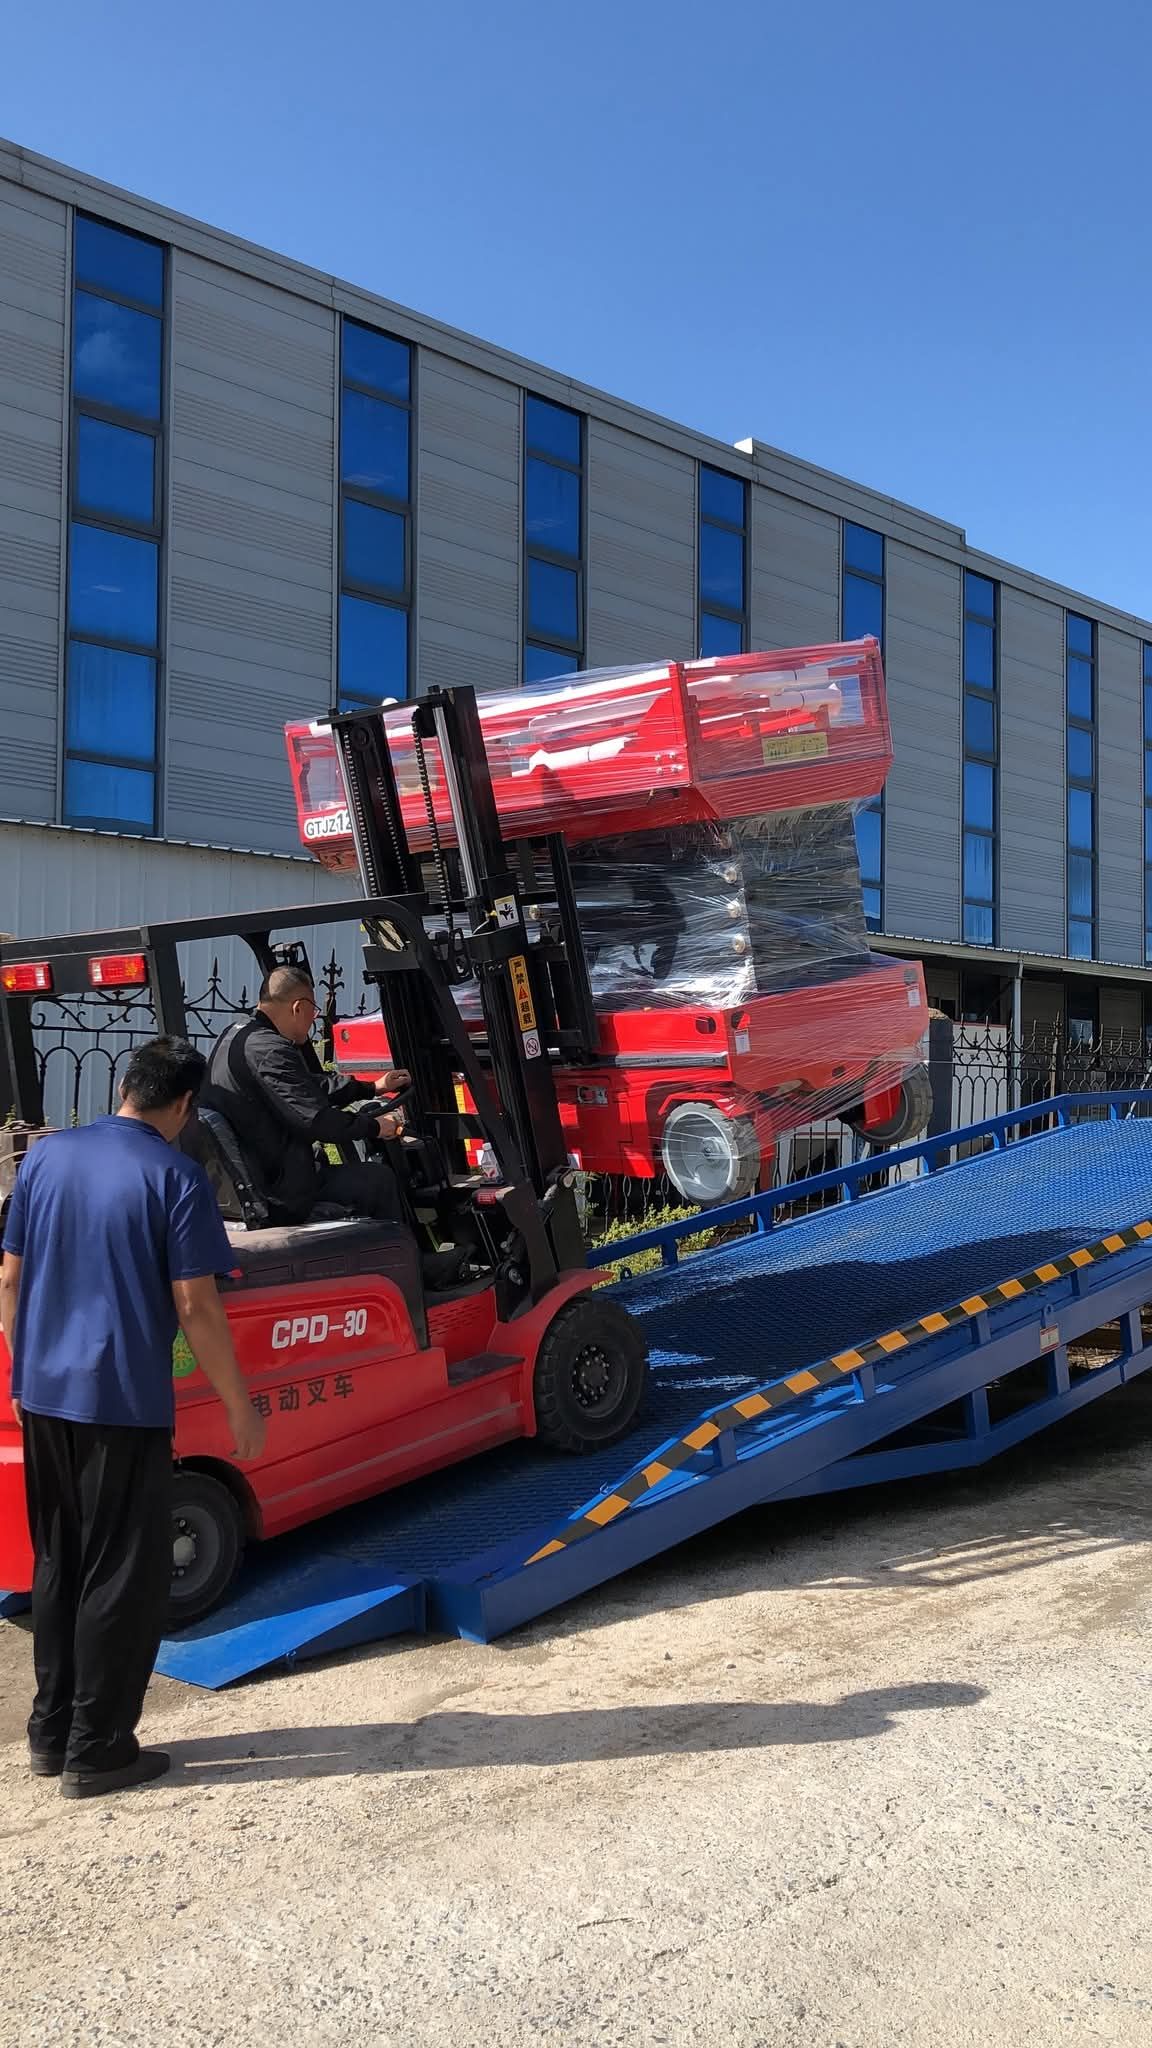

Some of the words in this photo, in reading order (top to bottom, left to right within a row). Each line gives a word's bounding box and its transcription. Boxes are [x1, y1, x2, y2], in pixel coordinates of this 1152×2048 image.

[272, 1308, 367, 1349] CPD-30
[249, 1374, 354, 1418] 电动叉车
